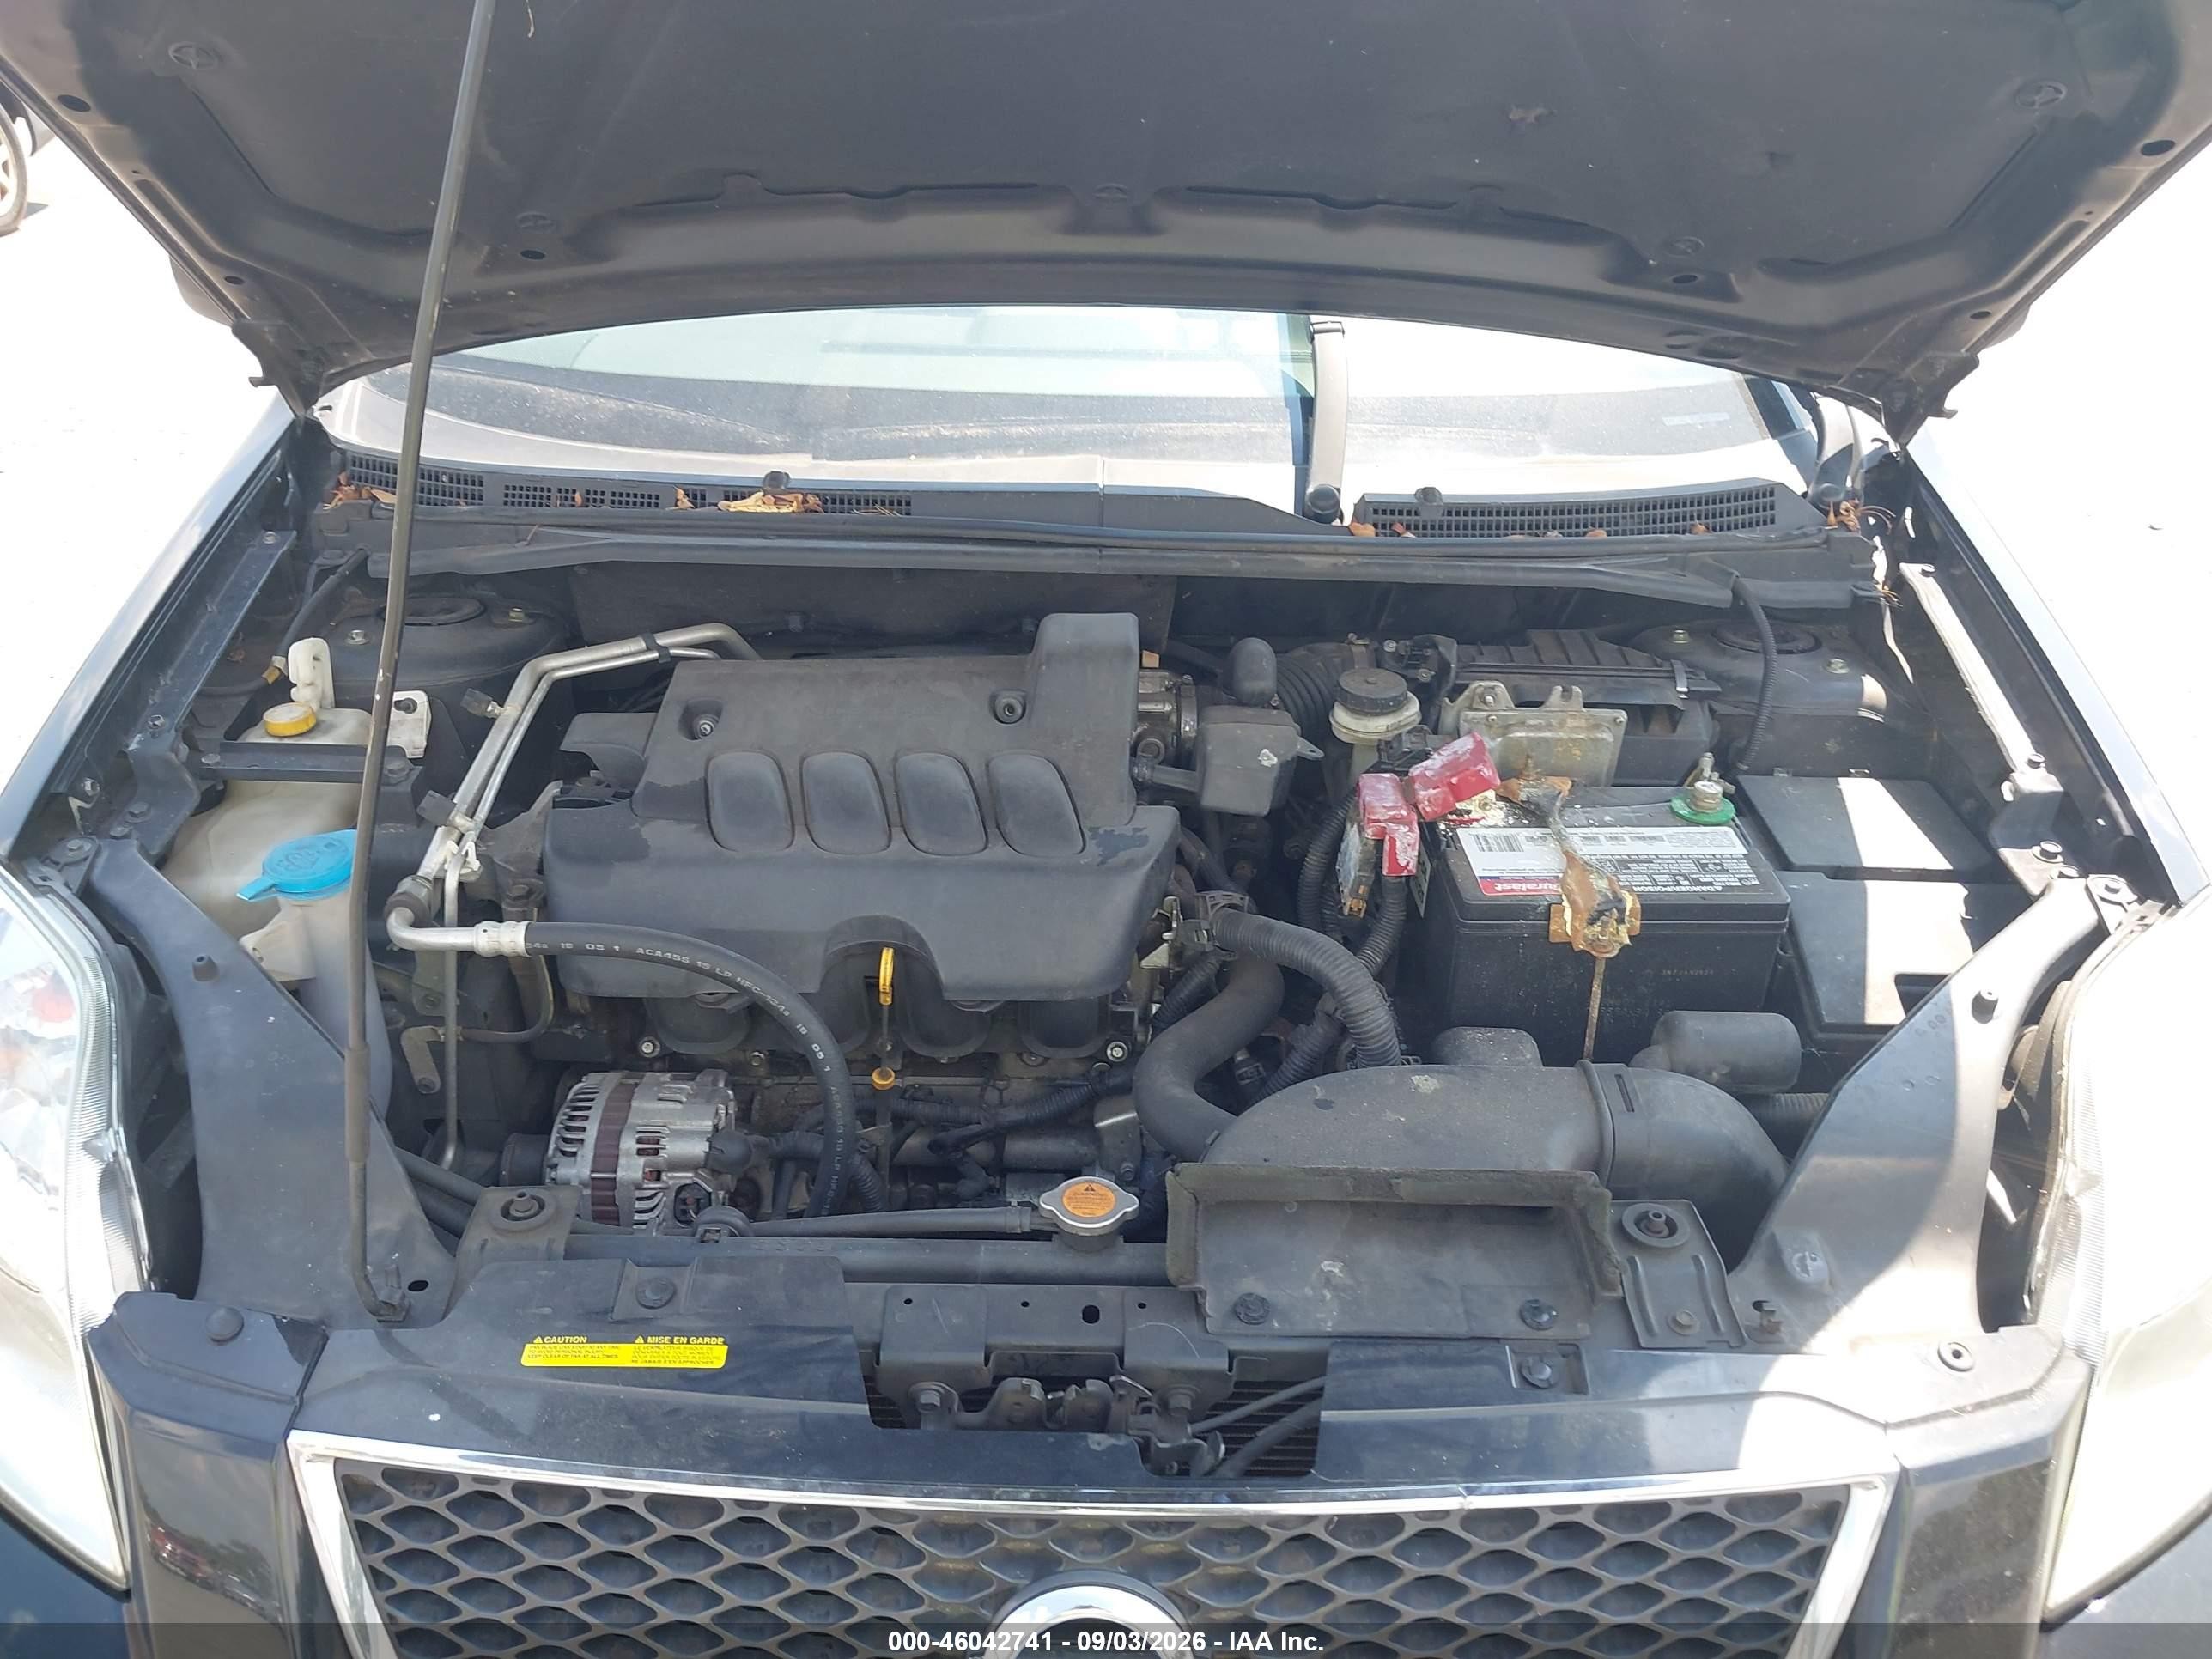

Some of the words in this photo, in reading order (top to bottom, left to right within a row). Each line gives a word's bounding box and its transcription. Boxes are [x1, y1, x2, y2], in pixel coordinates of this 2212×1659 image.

[544, 1335, 587, 1344] CAUTION
[647, 1335, 672, 1345] MISE
[673, 1336, 689, 1345] EN
[690, 1336, 726, 1346] GARDE
